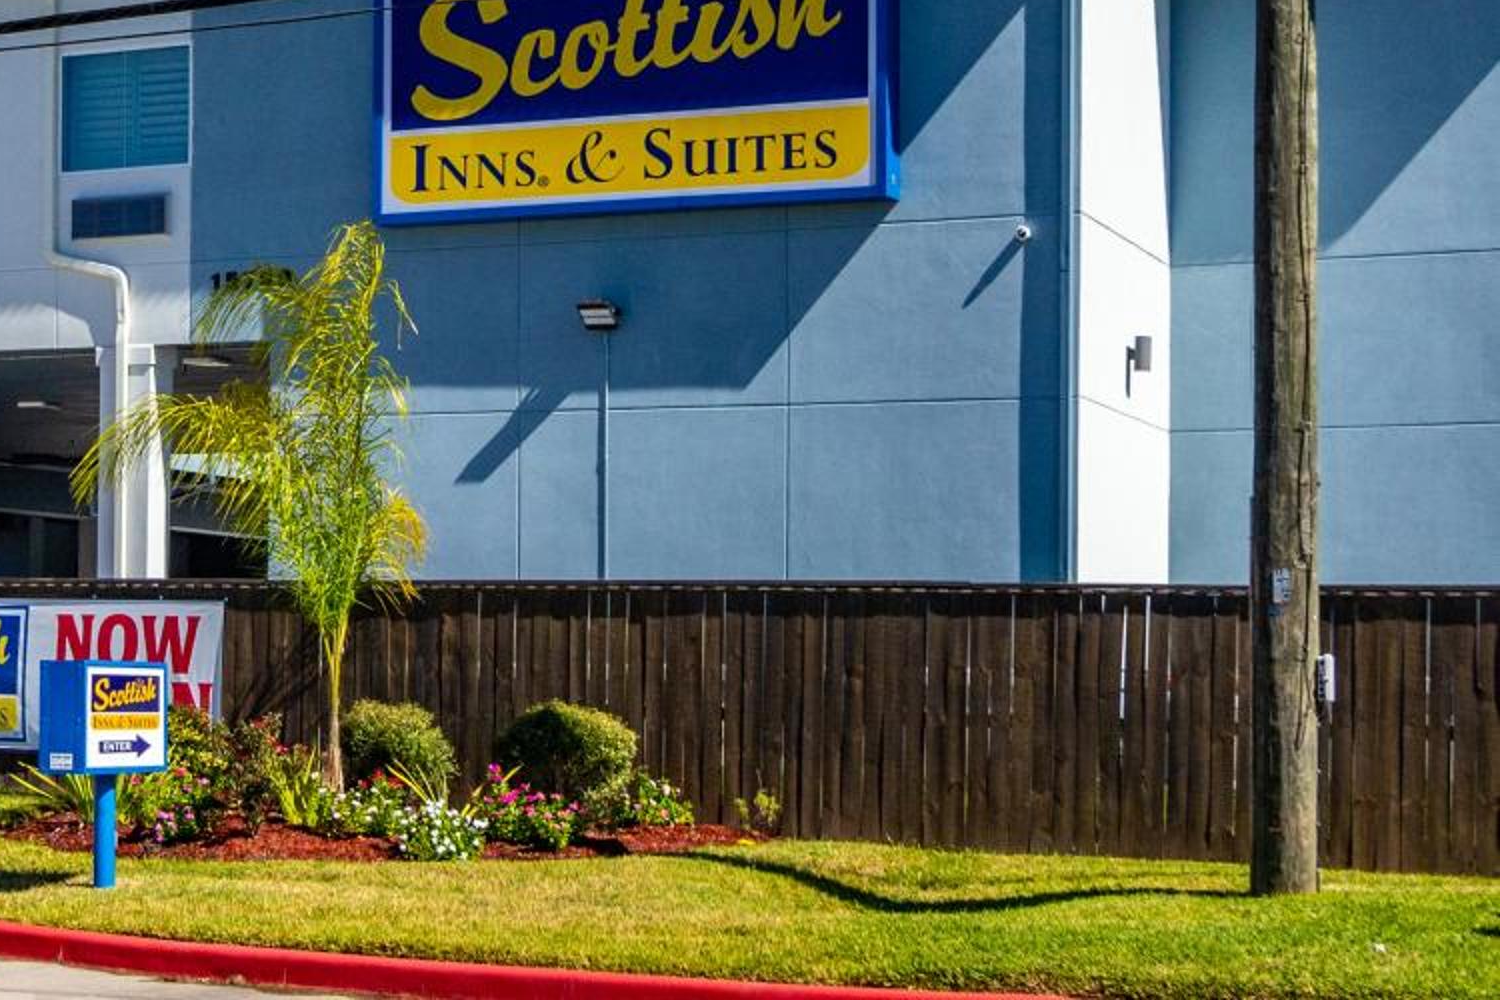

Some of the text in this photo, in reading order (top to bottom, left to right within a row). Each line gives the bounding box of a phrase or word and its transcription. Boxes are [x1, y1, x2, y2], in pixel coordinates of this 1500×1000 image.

[565, 131, 625, 184] &
[643, 127, 838, 180] SUITES
[56, 613, 200, 673] NOW
[94, 678, 156, 711] Scottish
[103, 742, 132, 751] ENTER
